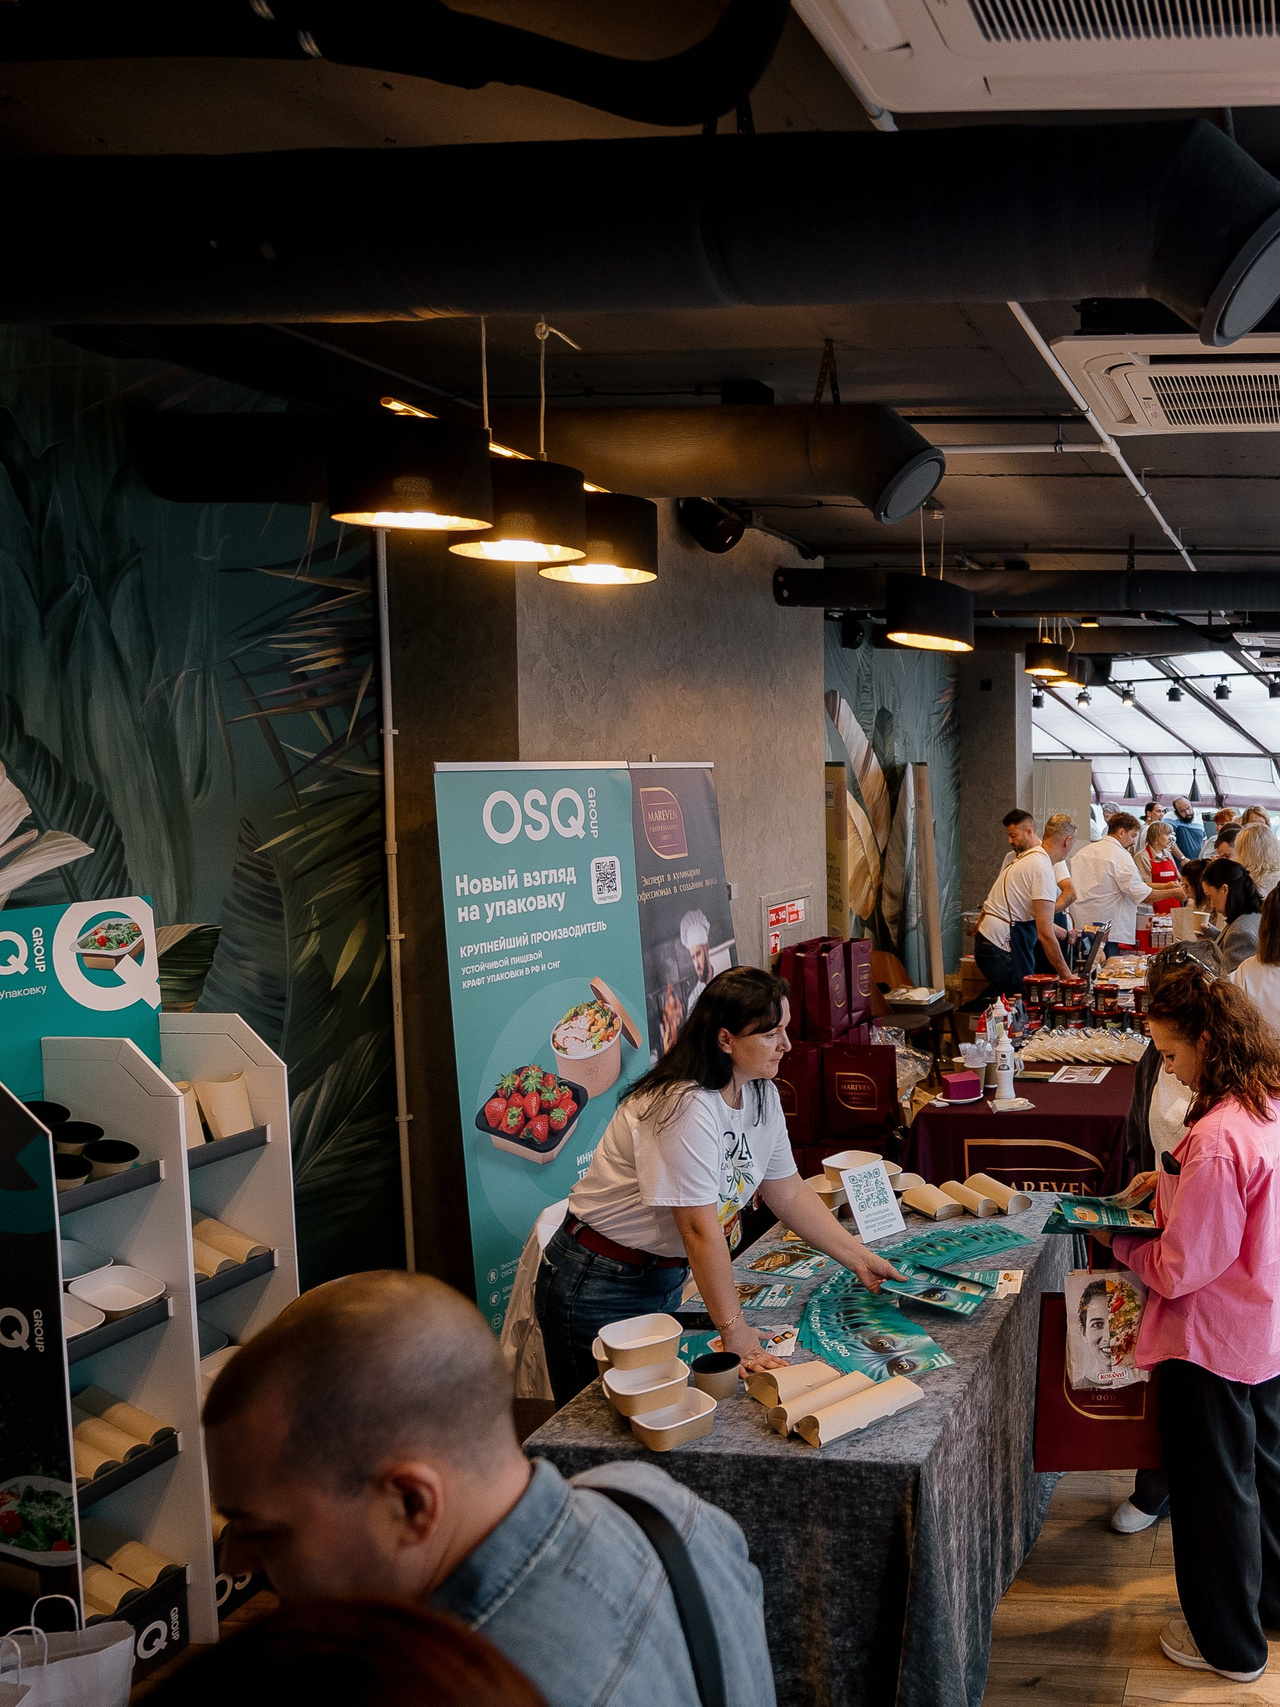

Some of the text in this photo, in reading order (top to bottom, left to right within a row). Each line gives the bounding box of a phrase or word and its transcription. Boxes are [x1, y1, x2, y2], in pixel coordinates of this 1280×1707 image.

[482, 787, 586, 844] OSQ
[587, 786, 599, 840] GROUP
[648, 809, 678, 822] MAREVEN
[455, 866, 577, 897] Новый взгляд
[641, 868, 702, 888] Эксперт в кулинарии
[457, 891, 566, 924] на упаковку
[637, 887, 672, 904] офессионал
[32, 927, 46, 973] GROUP
[460, 920, 607, 958] КРУПНЕЙШИЙ ПРОИЗВОДИТЕЛЬ
[461, 949, 543, 976] УСТОЙЧИВОЙ ПИЩЕВОЙ
[462, 960, 561, 989] КРАФТ УПАКОВКИ В РФ И СНГ
[1010, 1181, 1097, 1197] AREVEN
[33, 1309, 45, 1353] GROUP
[170, 1606, 180, 1641] GROUP
